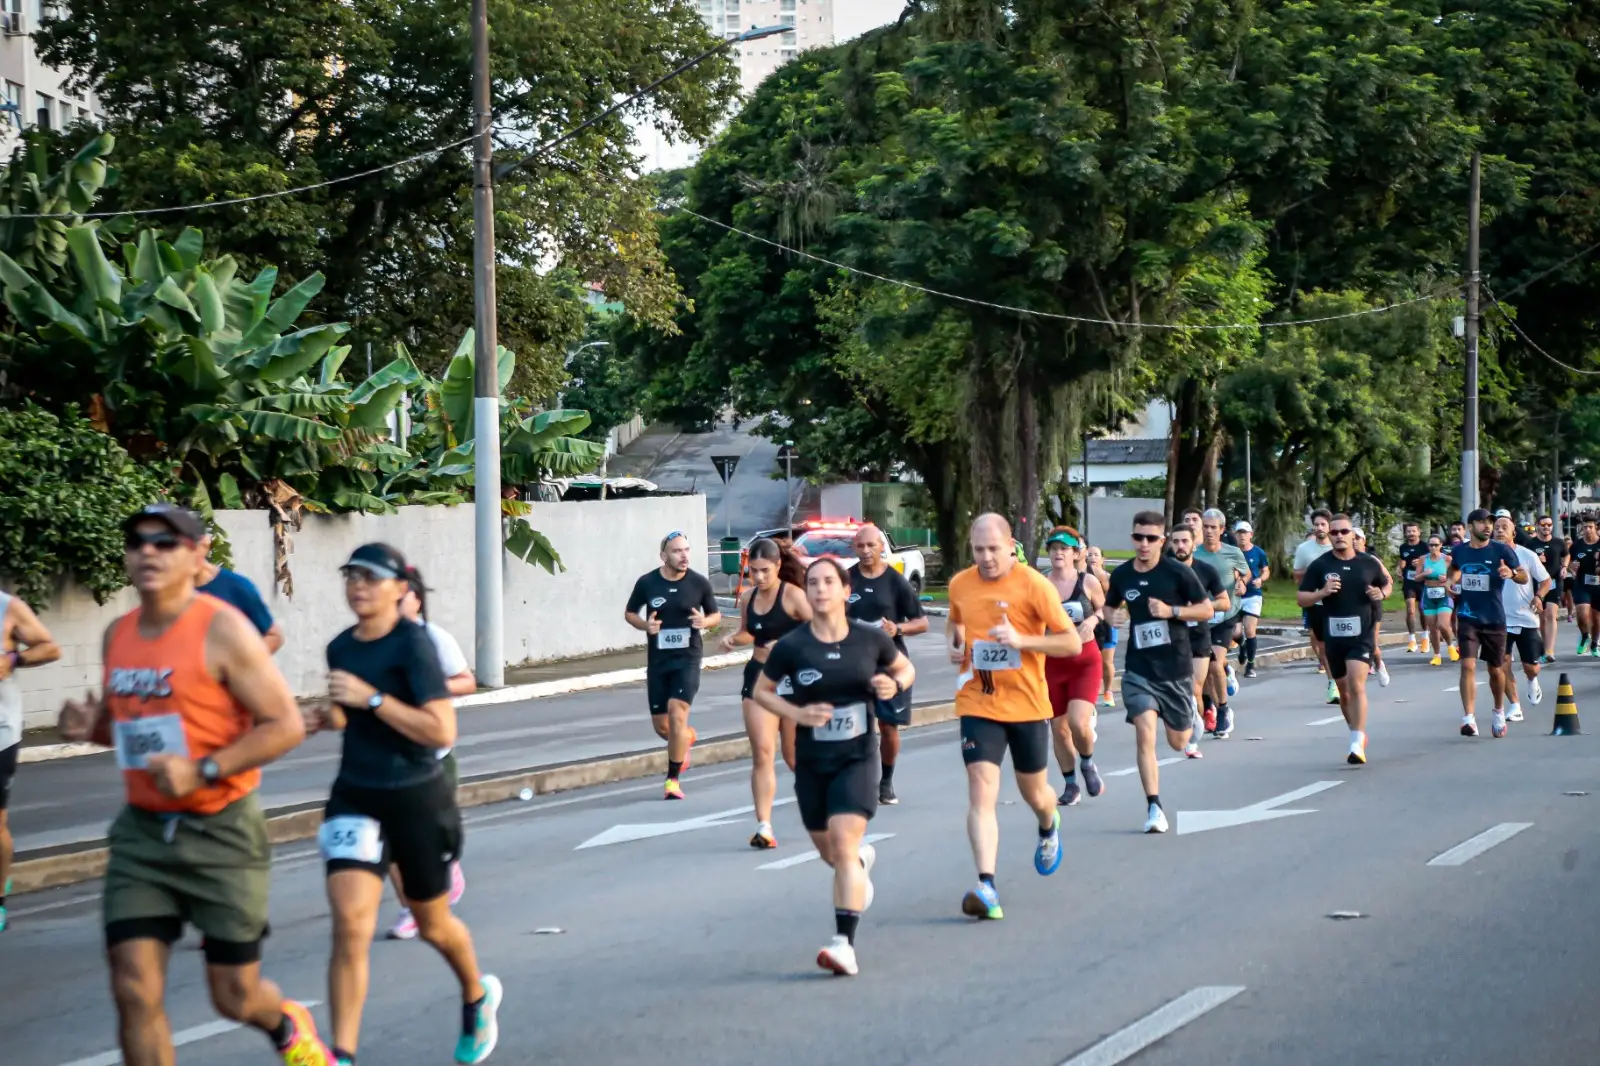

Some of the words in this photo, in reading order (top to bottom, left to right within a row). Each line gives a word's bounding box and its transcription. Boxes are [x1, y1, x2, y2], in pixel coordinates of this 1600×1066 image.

[1335, 622, 1353, 631] 196
[665, 634, 683, 643] 489
[1142, 628, 1162, 640] 516
[982, 649, 1009, 662] 322
